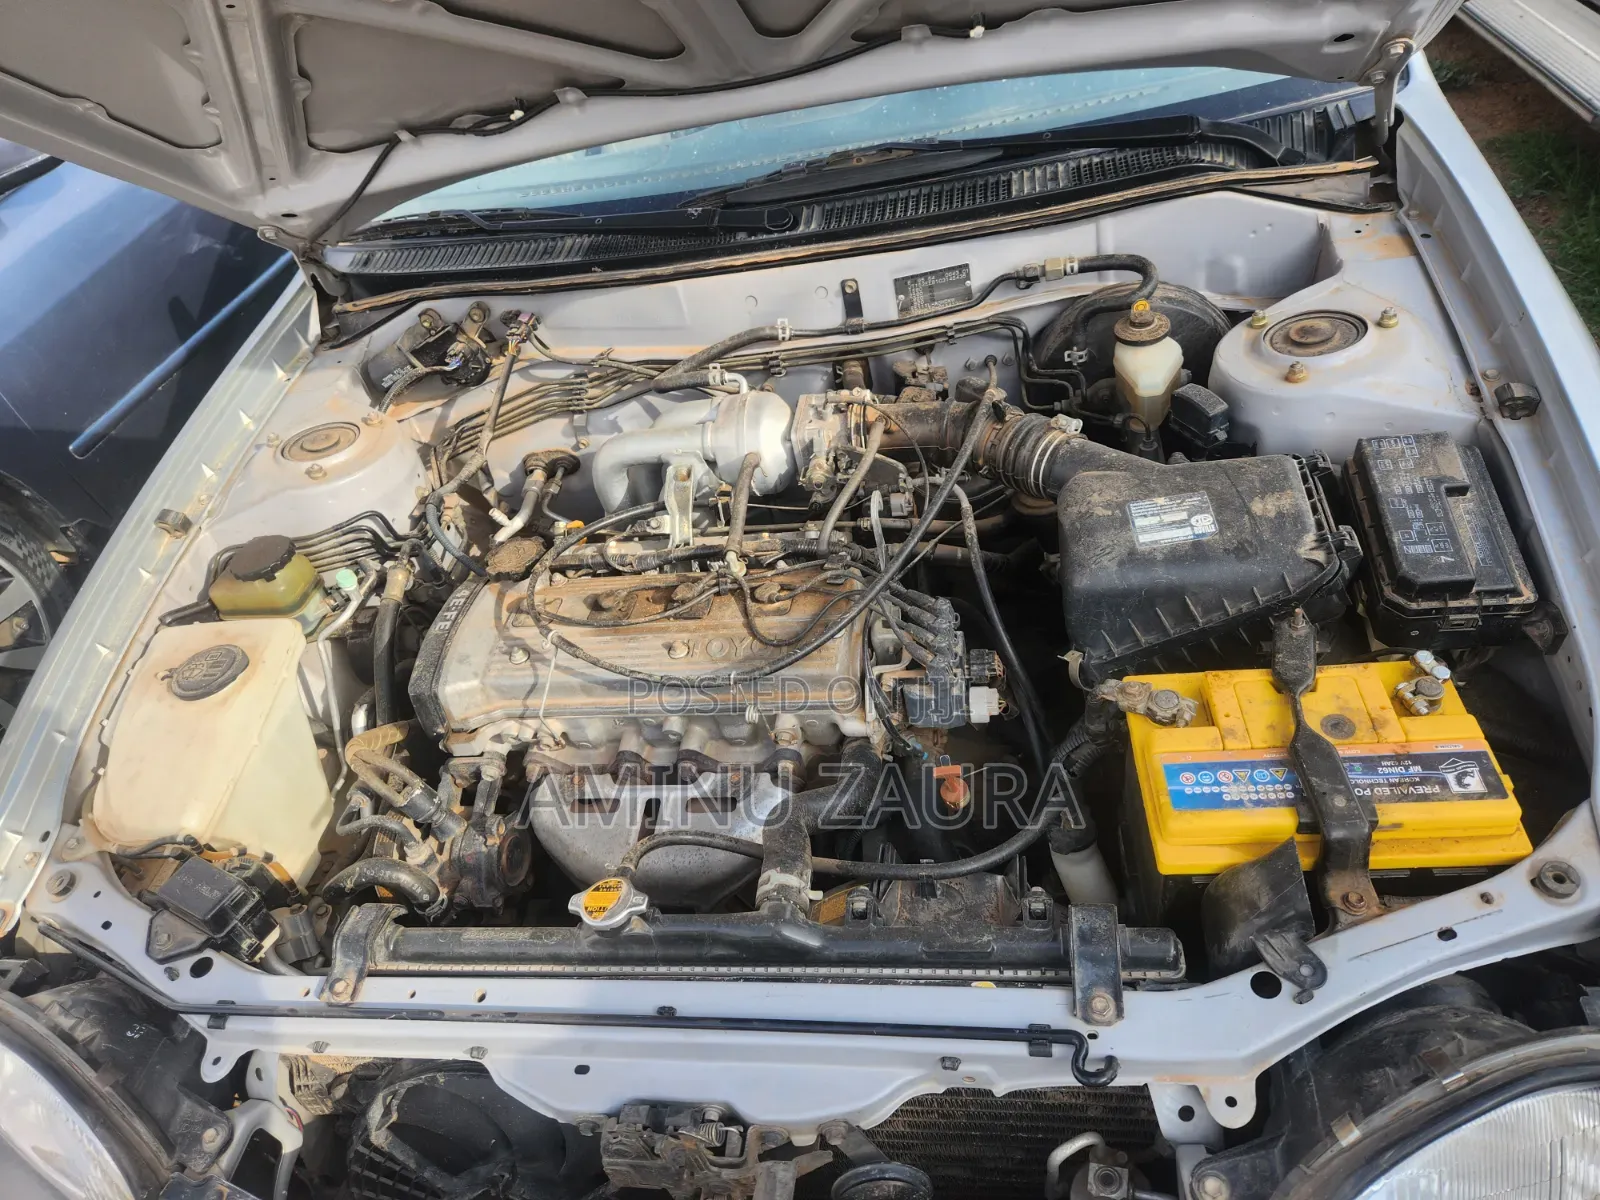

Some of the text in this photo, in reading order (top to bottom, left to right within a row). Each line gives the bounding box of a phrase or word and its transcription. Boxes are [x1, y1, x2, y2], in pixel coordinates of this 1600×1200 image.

[435, 590, 470, 631] 4E-FE
[1377, 766, 1406, 774] DIN62
[1374, 785, 1441, 796] PREVAILED
